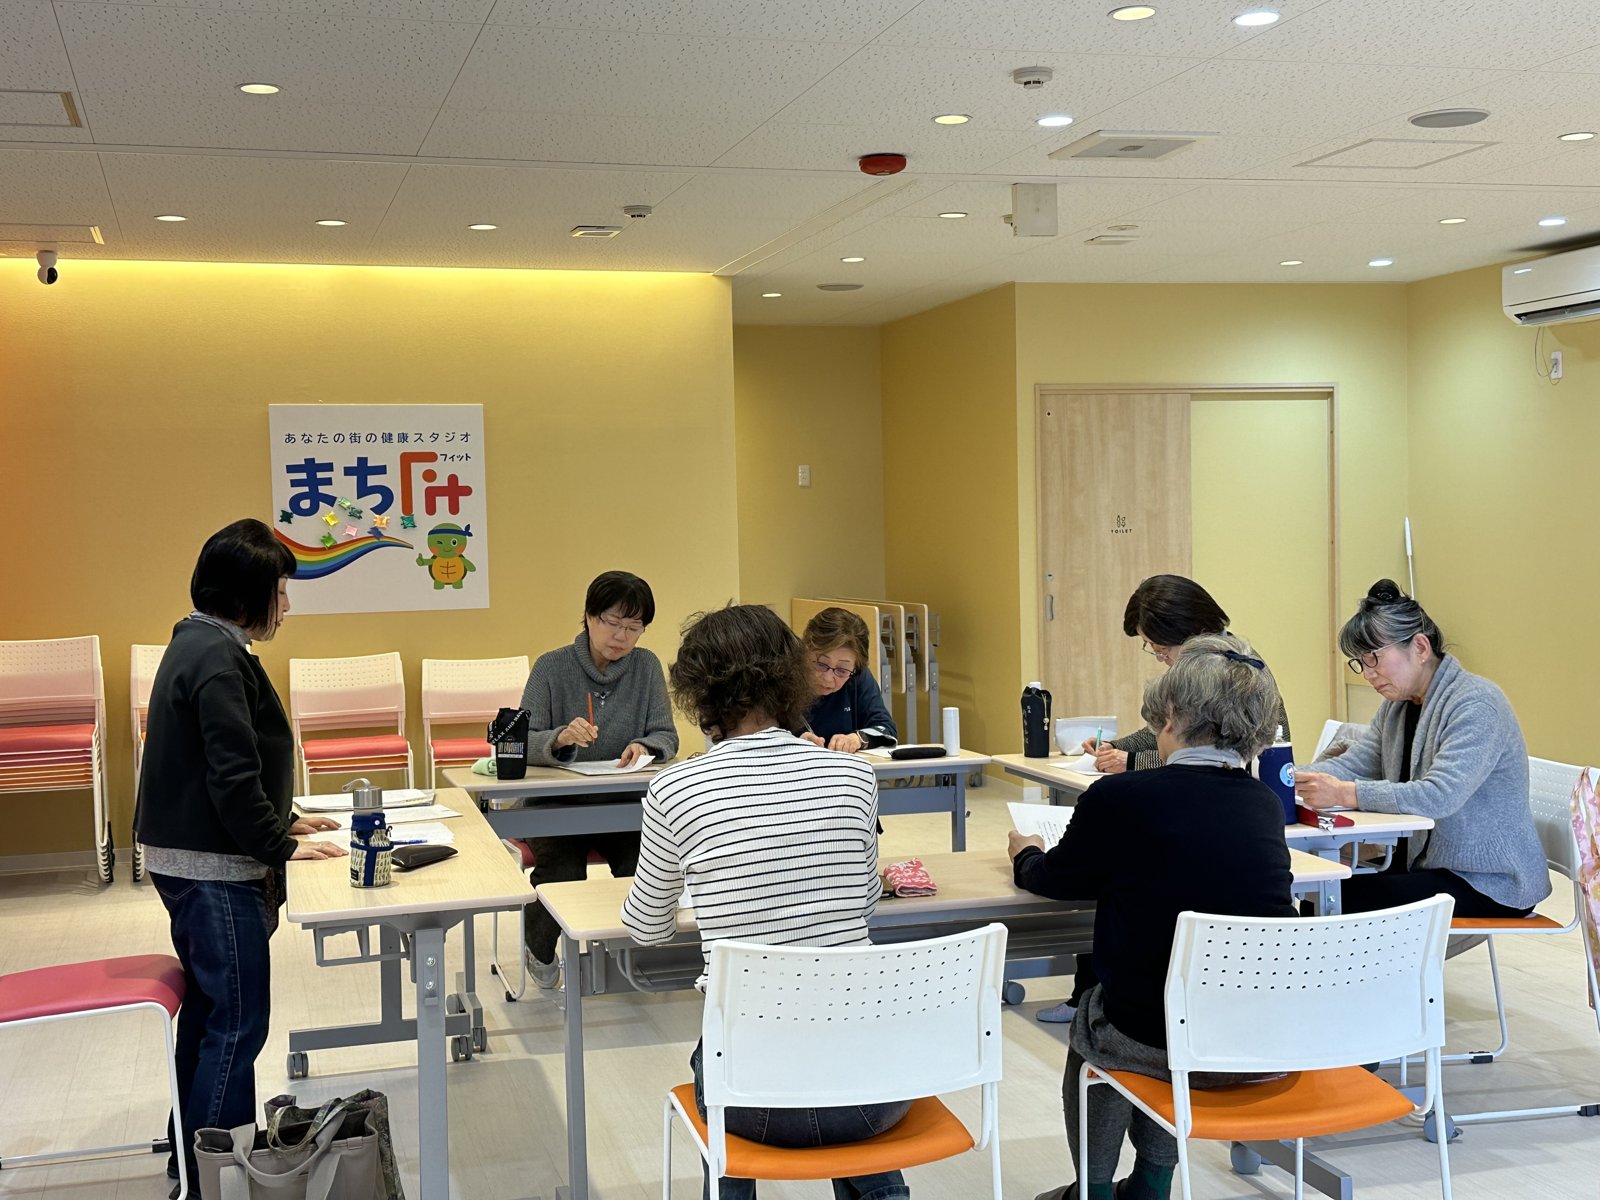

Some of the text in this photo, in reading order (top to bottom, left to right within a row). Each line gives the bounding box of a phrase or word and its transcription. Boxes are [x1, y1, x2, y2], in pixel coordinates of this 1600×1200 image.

[284, 432, 471, 444] あなたの街の健康スタジオ
[439, 453, 472, 462] フィット
